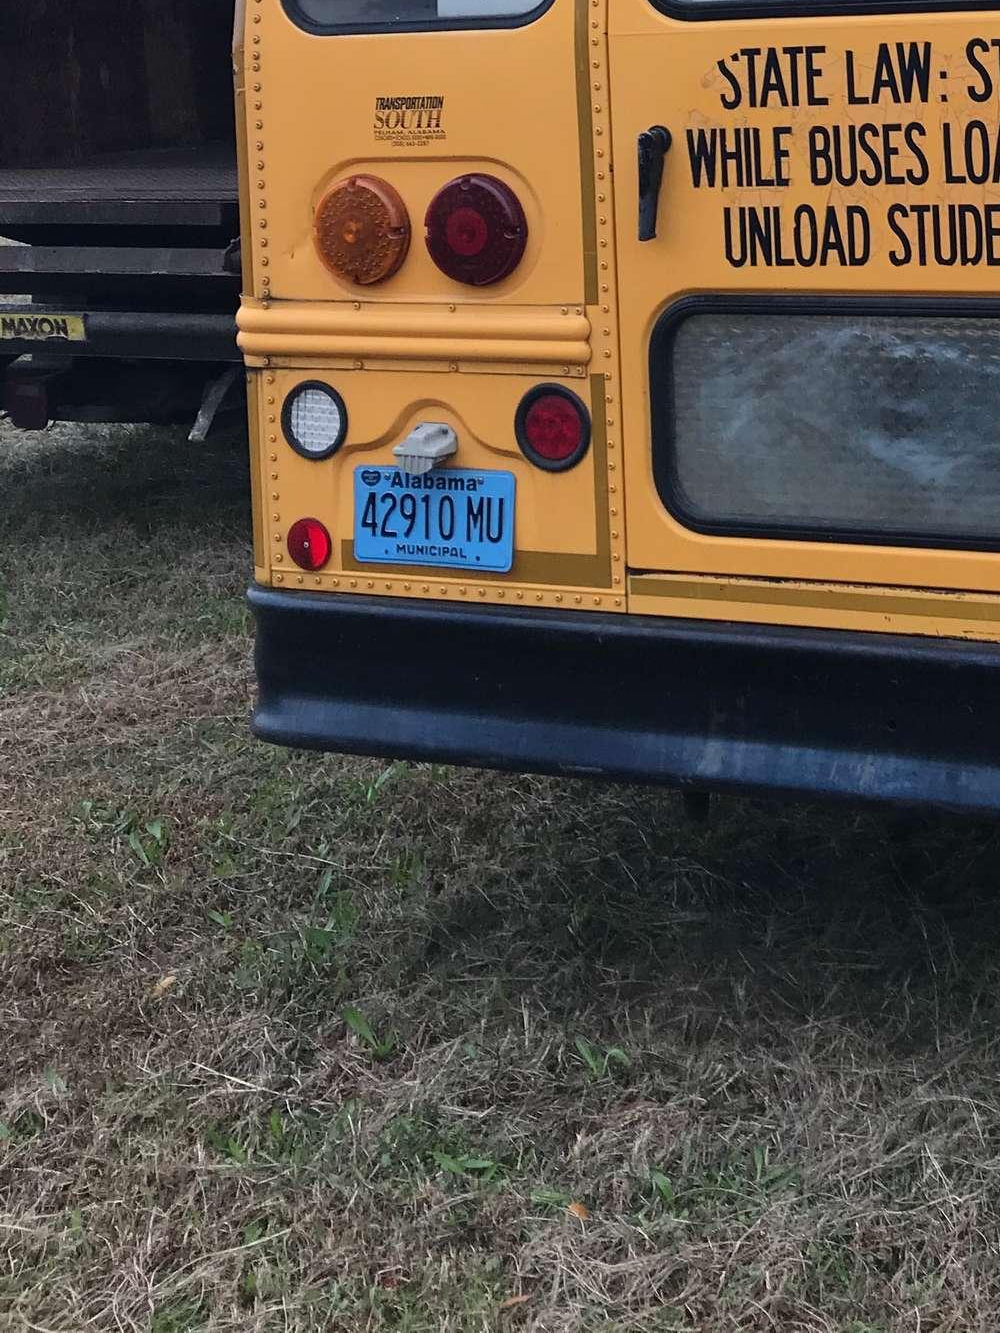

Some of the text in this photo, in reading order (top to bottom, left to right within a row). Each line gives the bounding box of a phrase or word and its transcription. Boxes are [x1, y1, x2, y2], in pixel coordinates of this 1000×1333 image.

[717, 45, 829, 109] STATE
[846, 42, 949, 105] LAW:
[375, 96, 444, 110] TRANSPORTATION
[373, 110, 441, 129] SOUTH
[687, 126, 793, 189] WHILE
[809, 122, 928, 187] BUSES
[723, 204, 871, 268] UNLOAD
[1, 317, 69, 337] MAXON
[390, 471, 478, 491] Alabama
[361, 491, 504, 544] 42910 MU
[396, 544, 467, 559] MUNICIPAL
